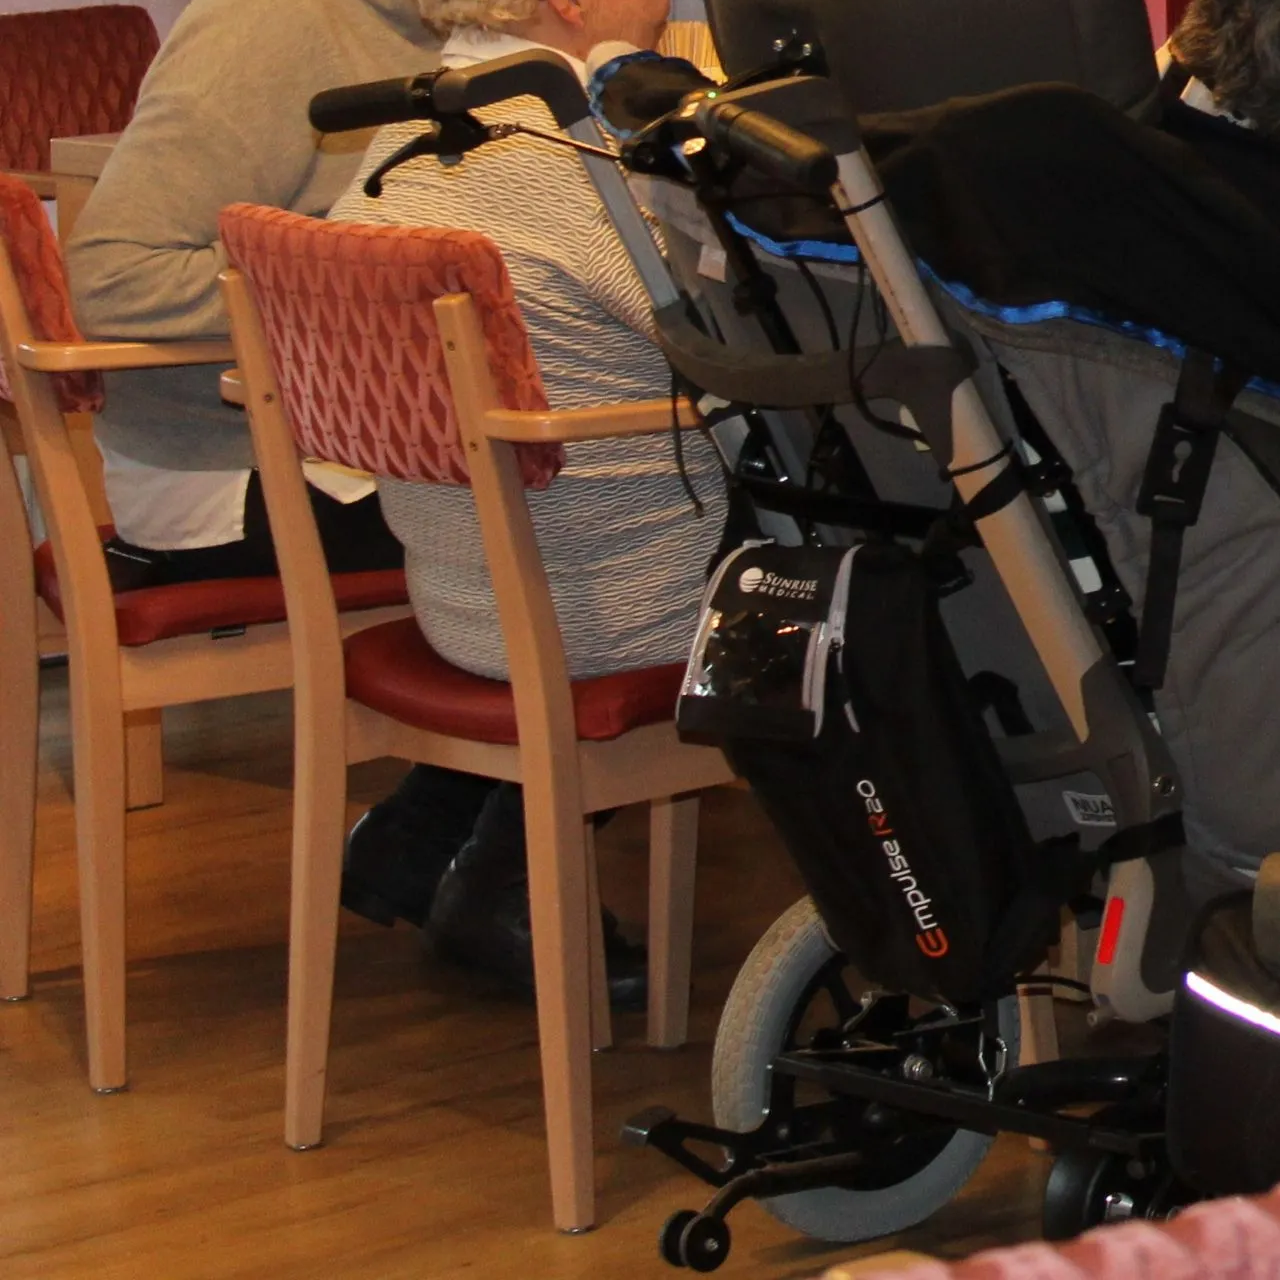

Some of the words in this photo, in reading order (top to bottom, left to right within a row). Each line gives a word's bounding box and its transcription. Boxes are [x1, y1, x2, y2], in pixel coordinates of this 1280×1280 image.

[758, 585, 814, 600] MEDICAL
[762, 572, 818, 592] SUNRISE
[856, 779, 894, 837] R20
[882, 839, 949, 958] Empulse
